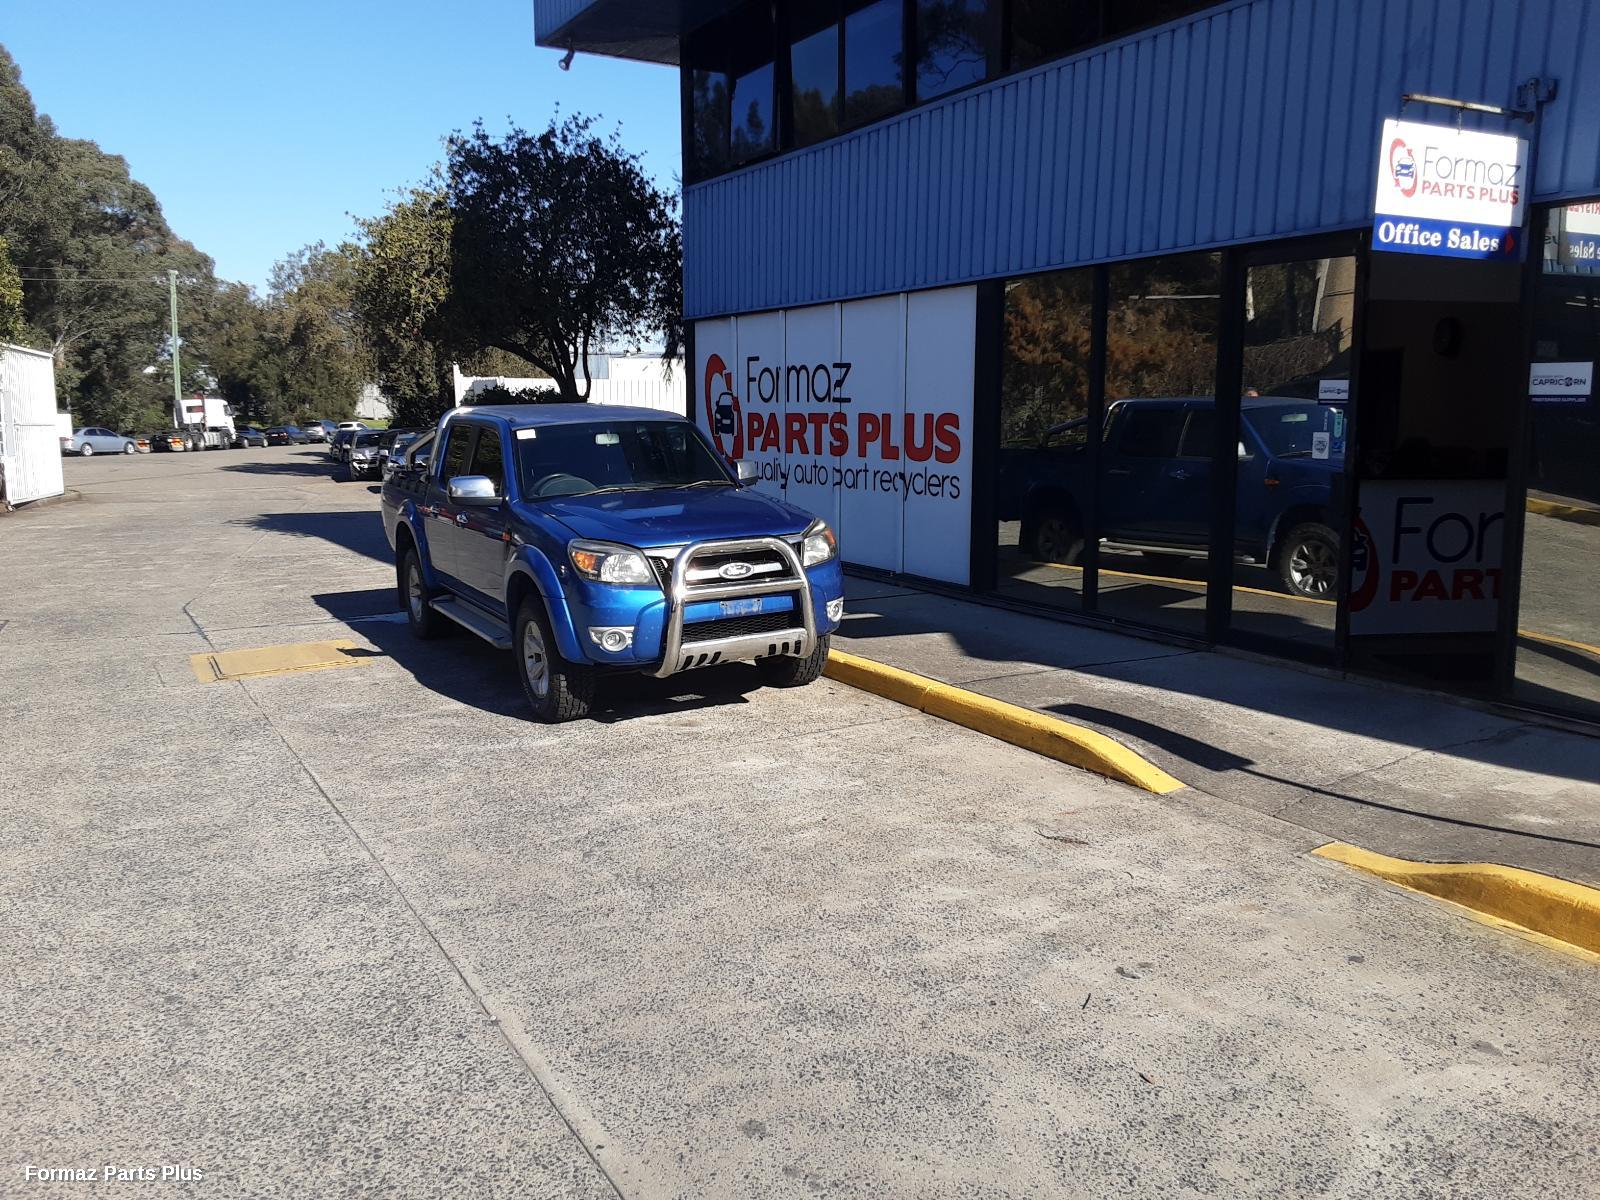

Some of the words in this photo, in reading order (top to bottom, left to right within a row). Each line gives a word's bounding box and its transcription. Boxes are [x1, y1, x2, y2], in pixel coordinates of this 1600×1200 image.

[1422, 146, 1522, 188] Formaz
[1422, 179, 1475, 199] PARTS
[1479, 190, 1520, 206] PLUS
[1378, 221, 1441, 247] Office
[1447, 227, 1500, 252] Sales
[746, 356, 852, 404] Formaz
[747, 412, 850, 457] PARTS
[858, 413, 961, 464] PLUS
[794, 460, 828, 485] auto
[873, 466, 961, 501] recyclers
